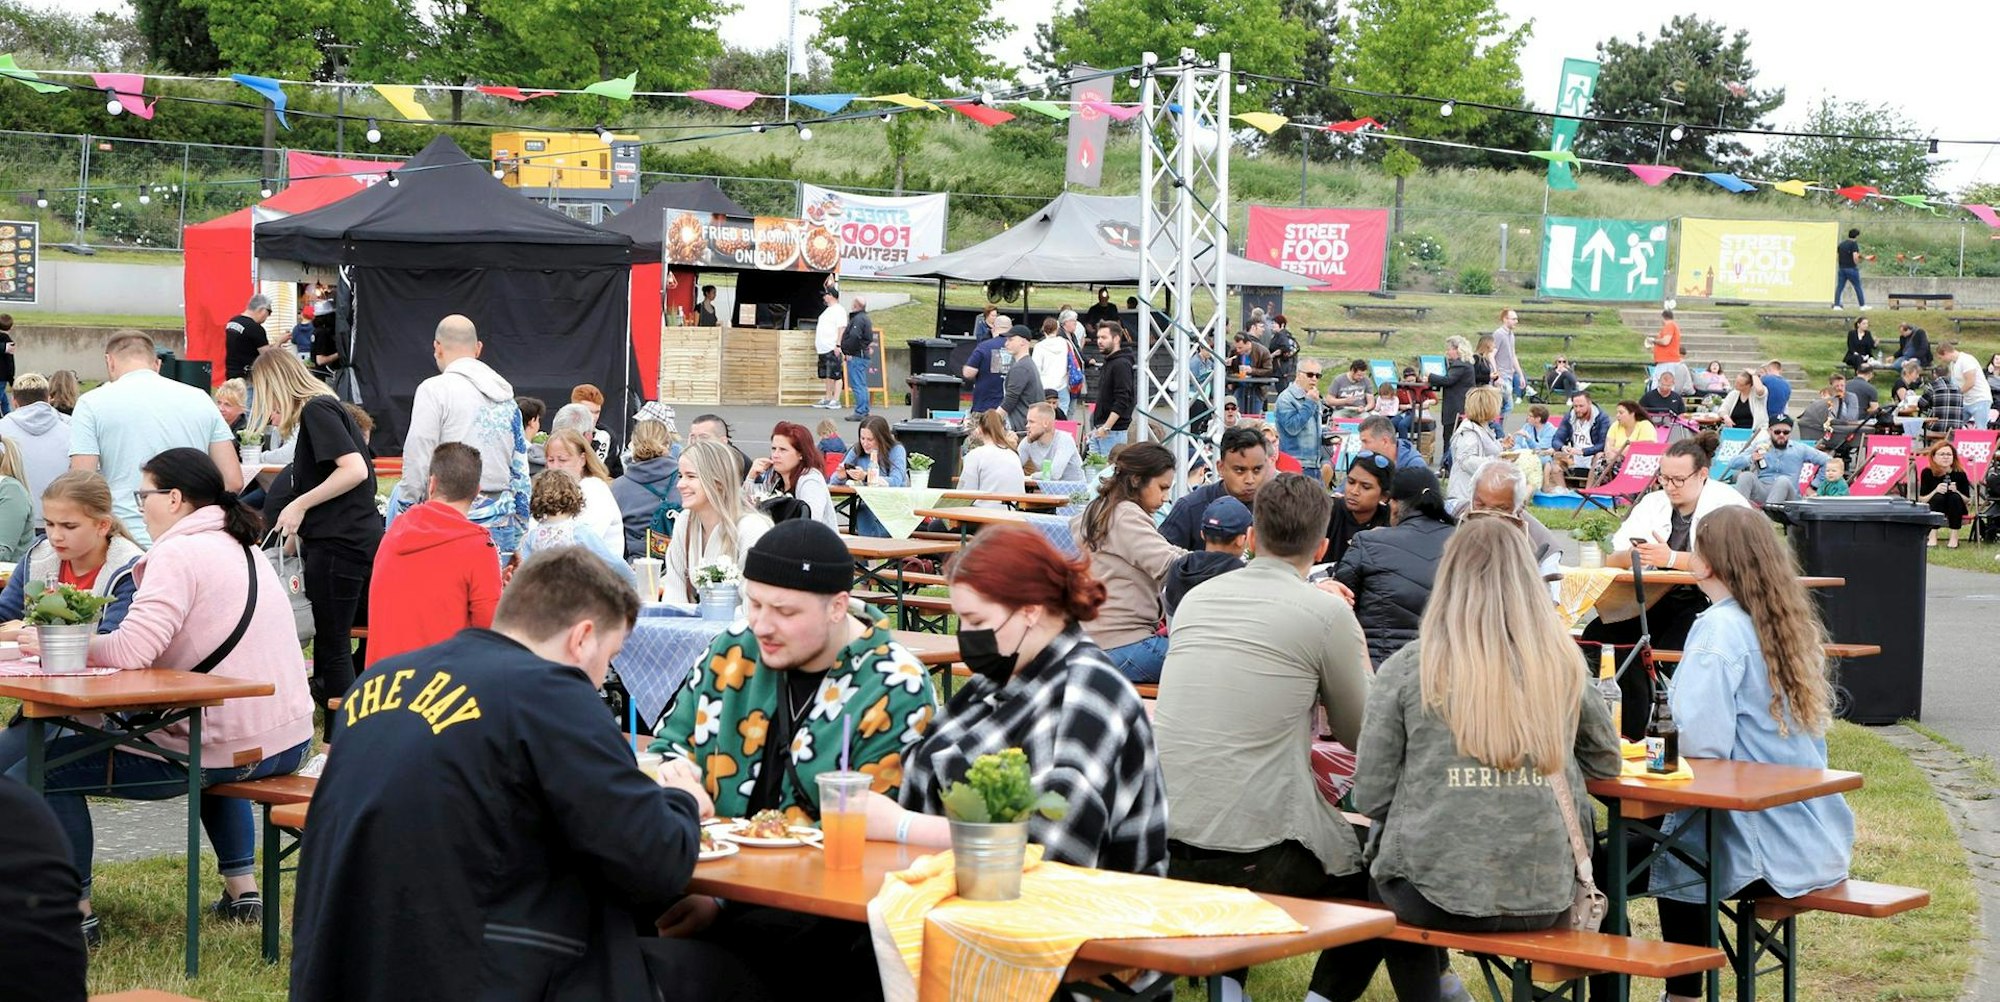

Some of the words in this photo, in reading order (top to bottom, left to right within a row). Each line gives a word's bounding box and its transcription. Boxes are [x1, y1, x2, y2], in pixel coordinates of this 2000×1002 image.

[702, 225, 738, 241] FRIED
[741, 226, 807, 245] BLOOMING
[1284, 223, 1350, 240] STREET
[1281, 240, 1349, 261] FOOD
[1720, 234, 1796, 251] STREET
[735, 250, 776, 264] ONION
[1718, 250, 1795, 271] FOOD
[1280, 261, 1346, 275] FESTIVAL
[344, 669, 416, 727] THE
[407, 671, 482, 735] BAY
[1447, 766, 1551, 788] HERITAG
